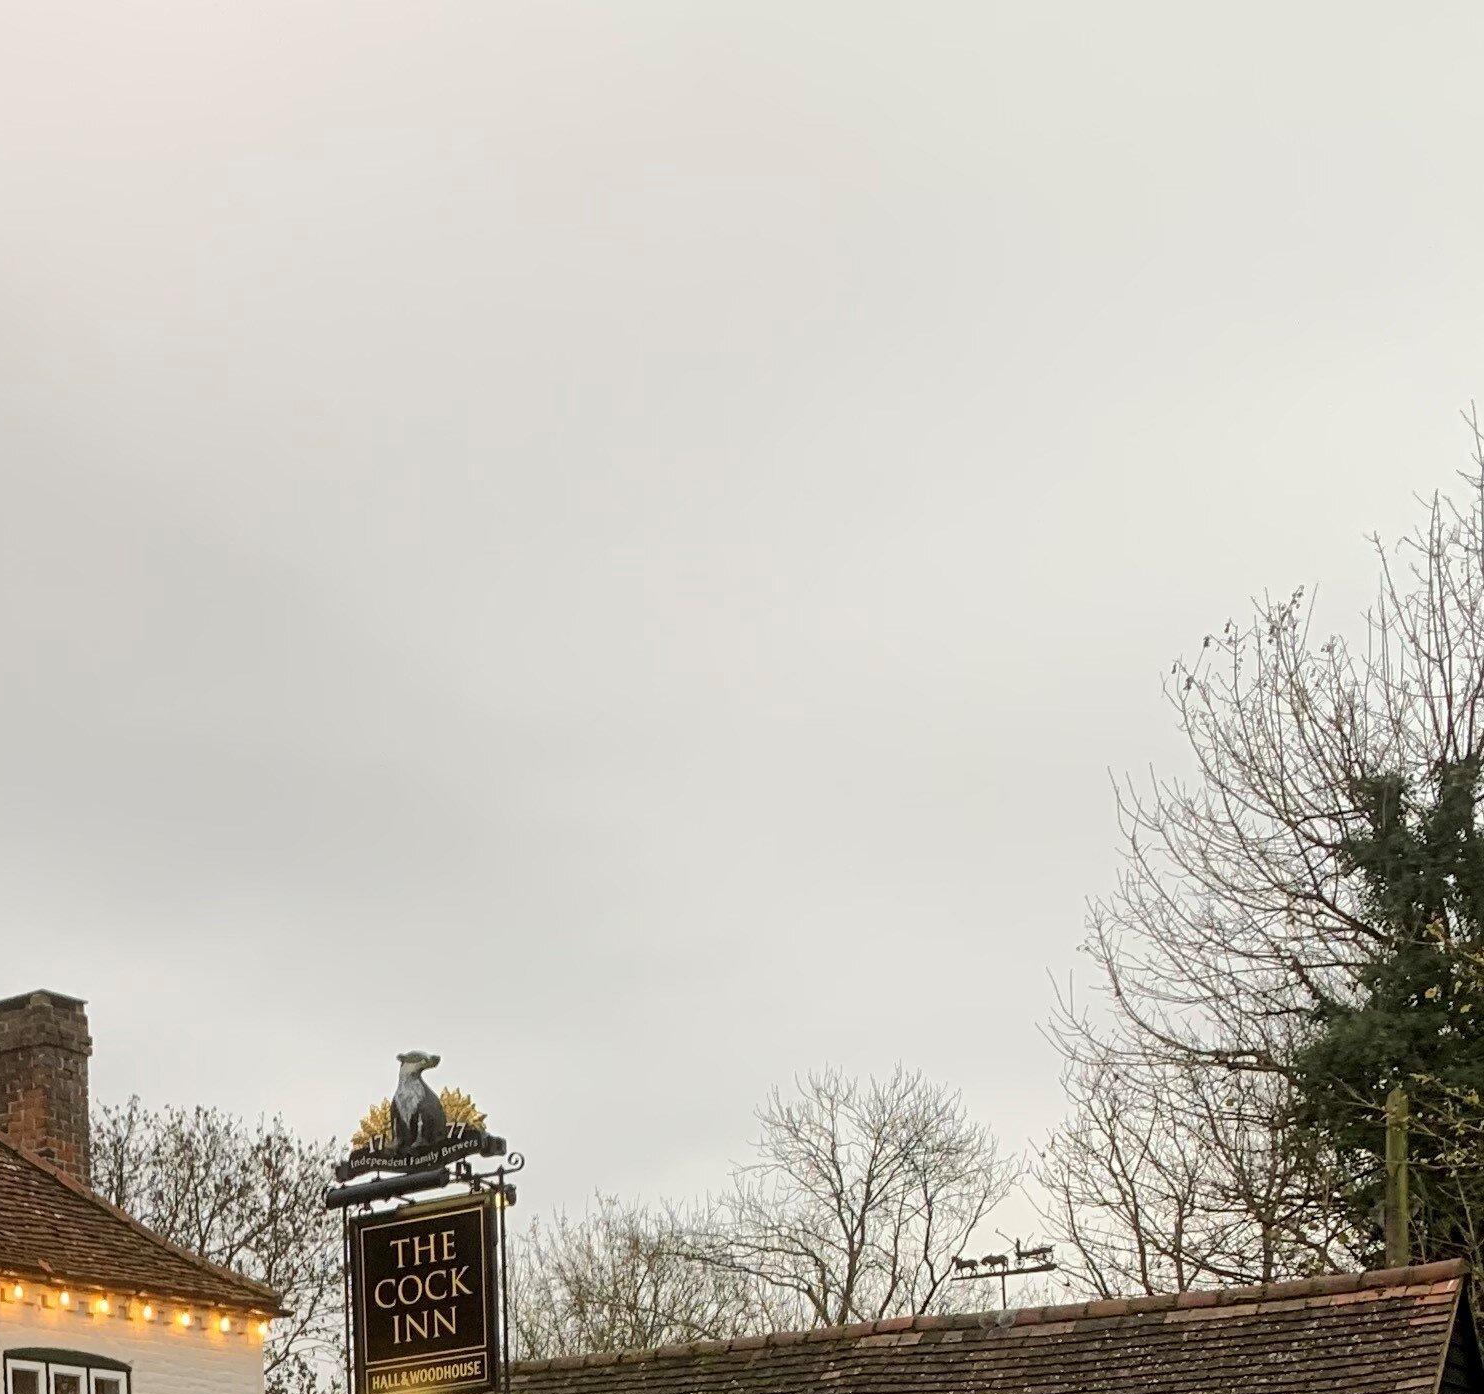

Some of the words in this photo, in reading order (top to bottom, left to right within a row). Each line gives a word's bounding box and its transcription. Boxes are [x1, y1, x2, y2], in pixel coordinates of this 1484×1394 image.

[350, 1155, 407, 1168] Independent
[410, 1150, 439, 1166] Family
[441, 1139, 479, 1157] Brewers
[369, 1133, 384, 1153] 17
[445, 1122, 466, 1139] 77
[390, 1230, 457, 1269] THE
[374, 1265, 474, 1309] COCK
[393, 1306, 457, 1344] INN
